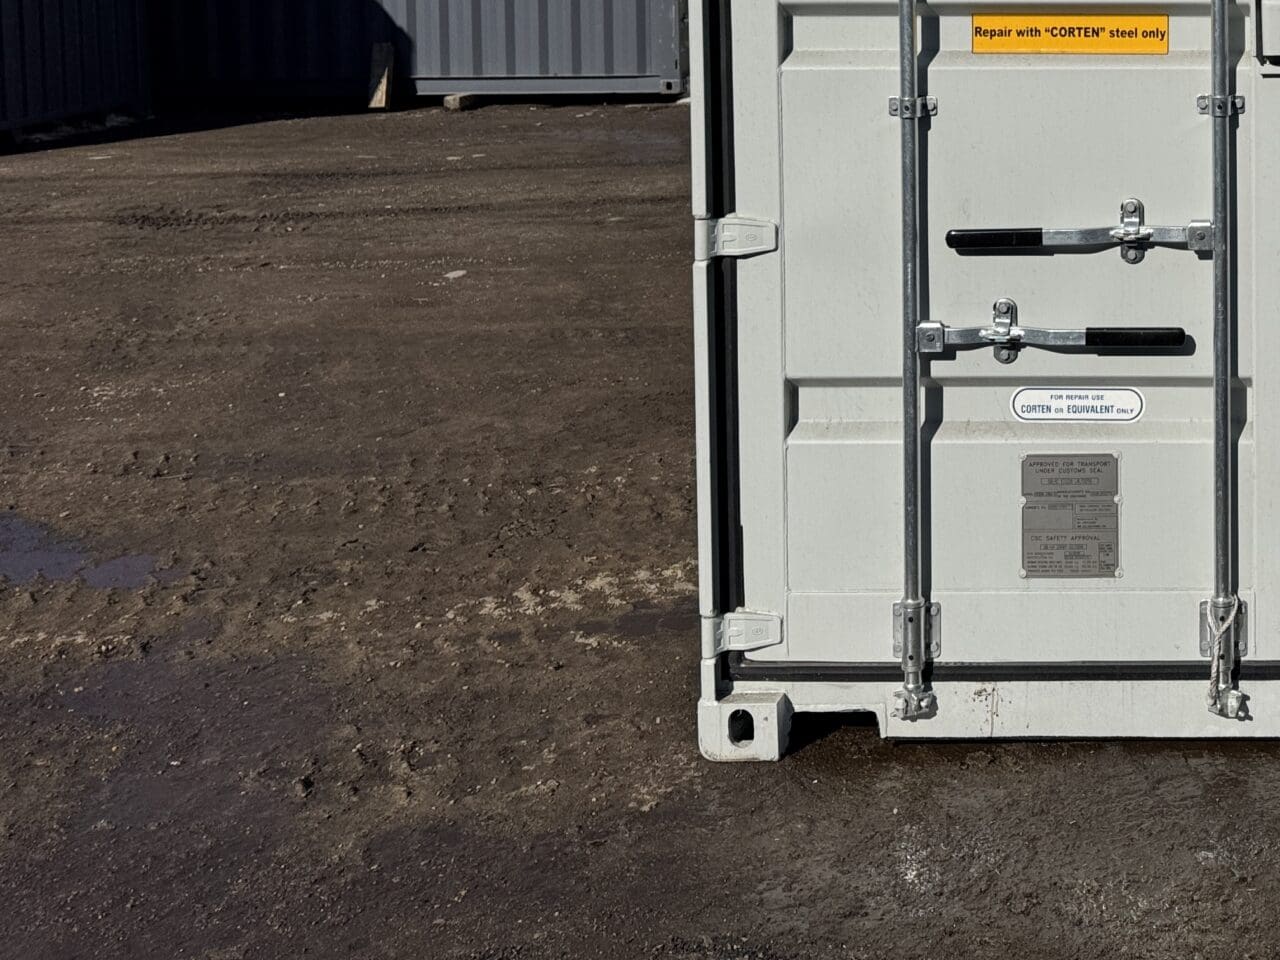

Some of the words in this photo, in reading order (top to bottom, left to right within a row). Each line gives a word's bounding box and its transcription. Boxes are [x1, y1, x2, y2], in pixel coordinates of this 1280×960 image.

[974, 26, 1012, 40] Repair
[1015, 27, 1041, 38] with
[1109, 28, 1138, 39] steel
[1141, 28, 1166, 41] only
[1021, 404, 1052, 414] CORTEN
[1067, 404, 1114, 414] EQUIVALENT
